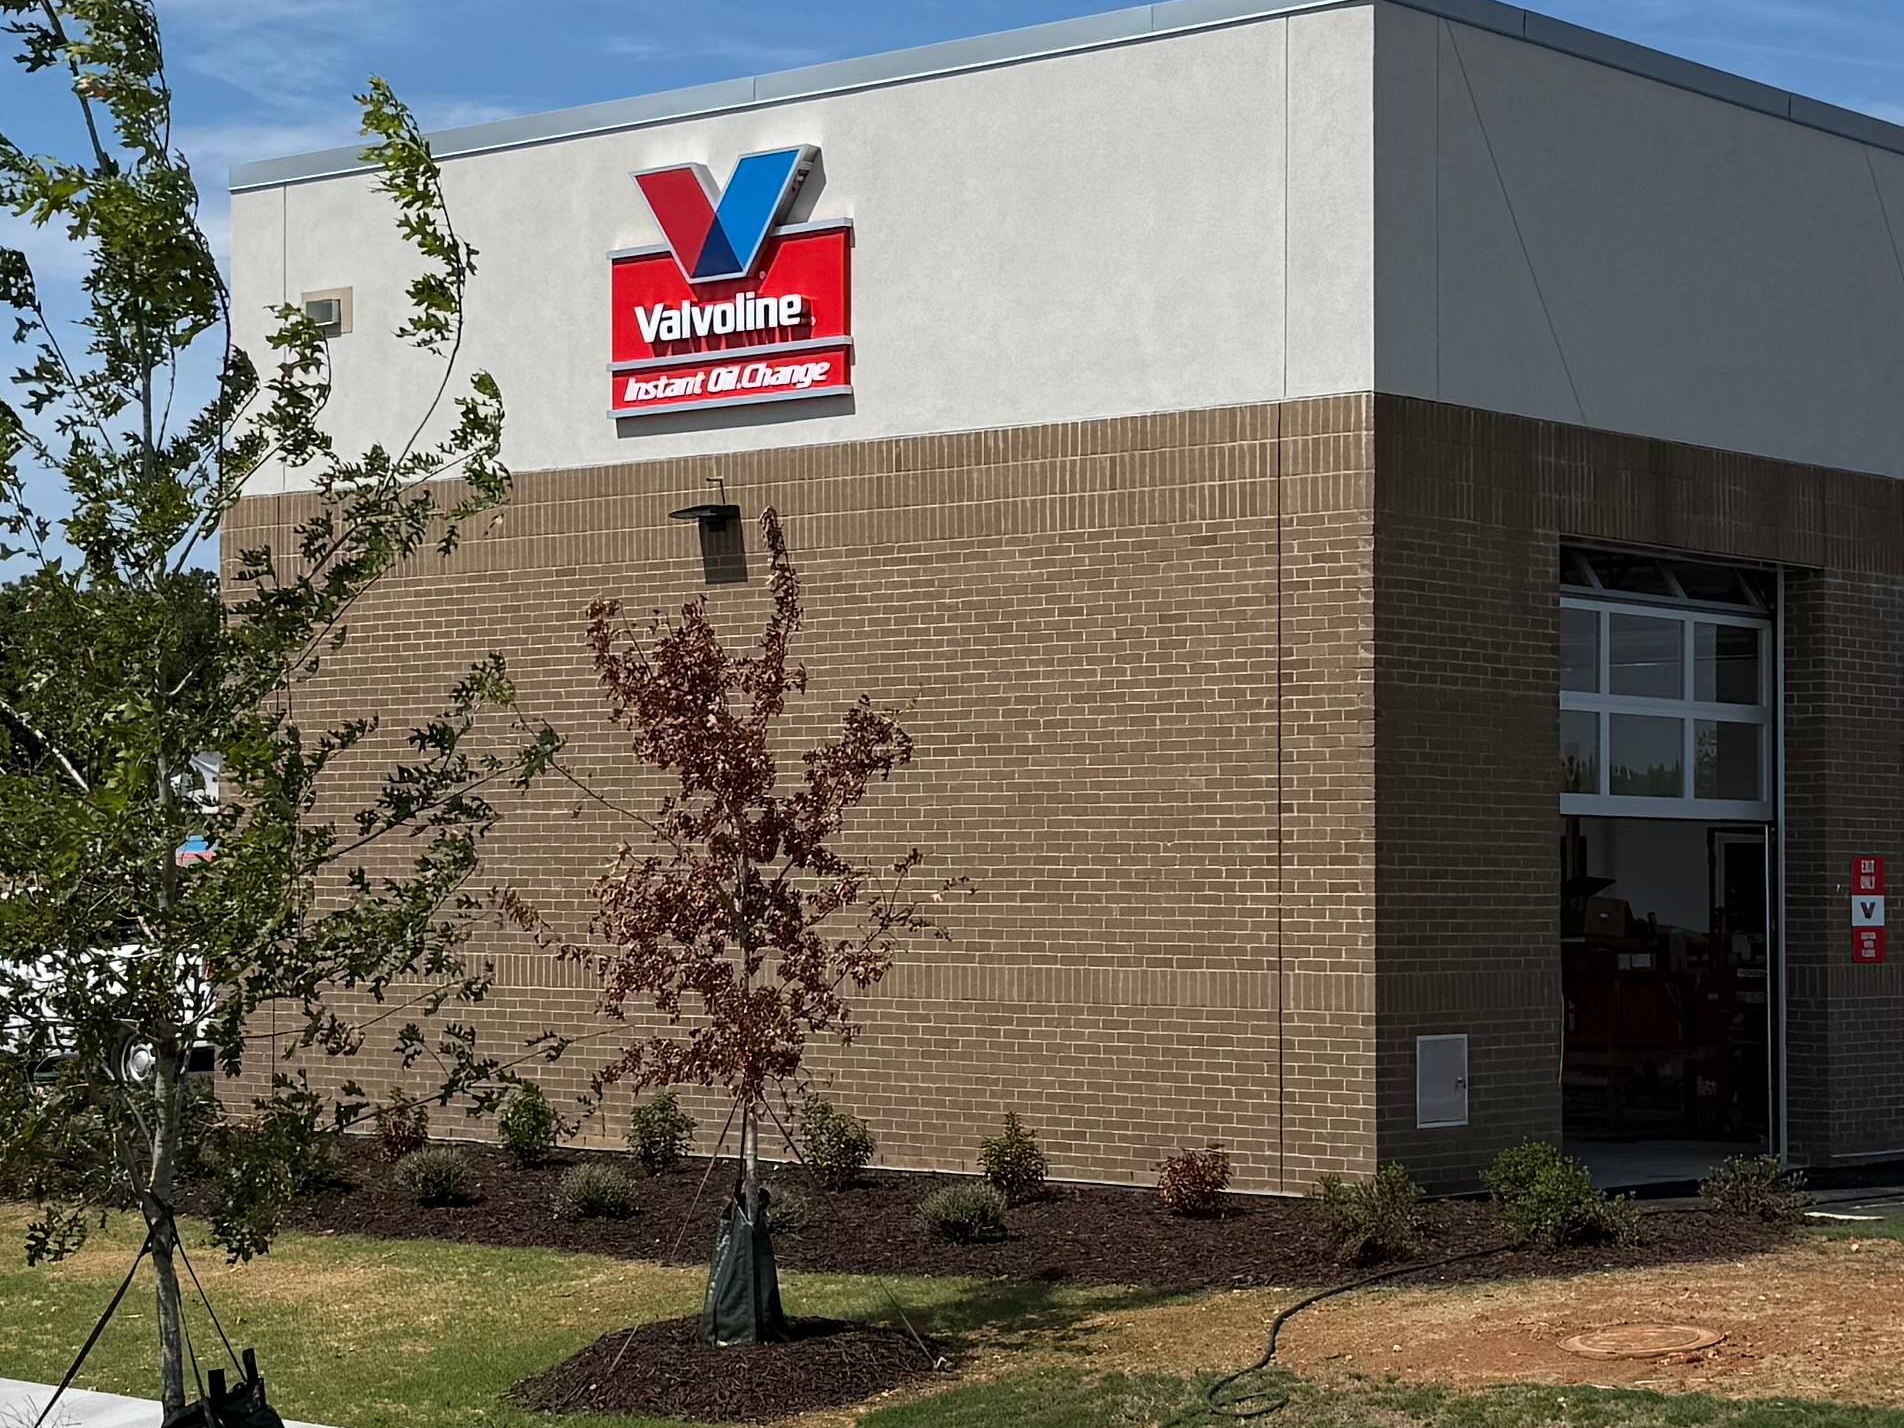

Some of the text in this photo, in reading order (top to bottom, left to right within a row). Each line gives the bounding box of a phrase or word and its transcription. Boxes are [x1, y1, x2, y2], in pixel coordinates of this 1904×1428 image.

[634, 291, 802, 343] Valvoline
[624, 361, 831, 402] Instant Oil Change
